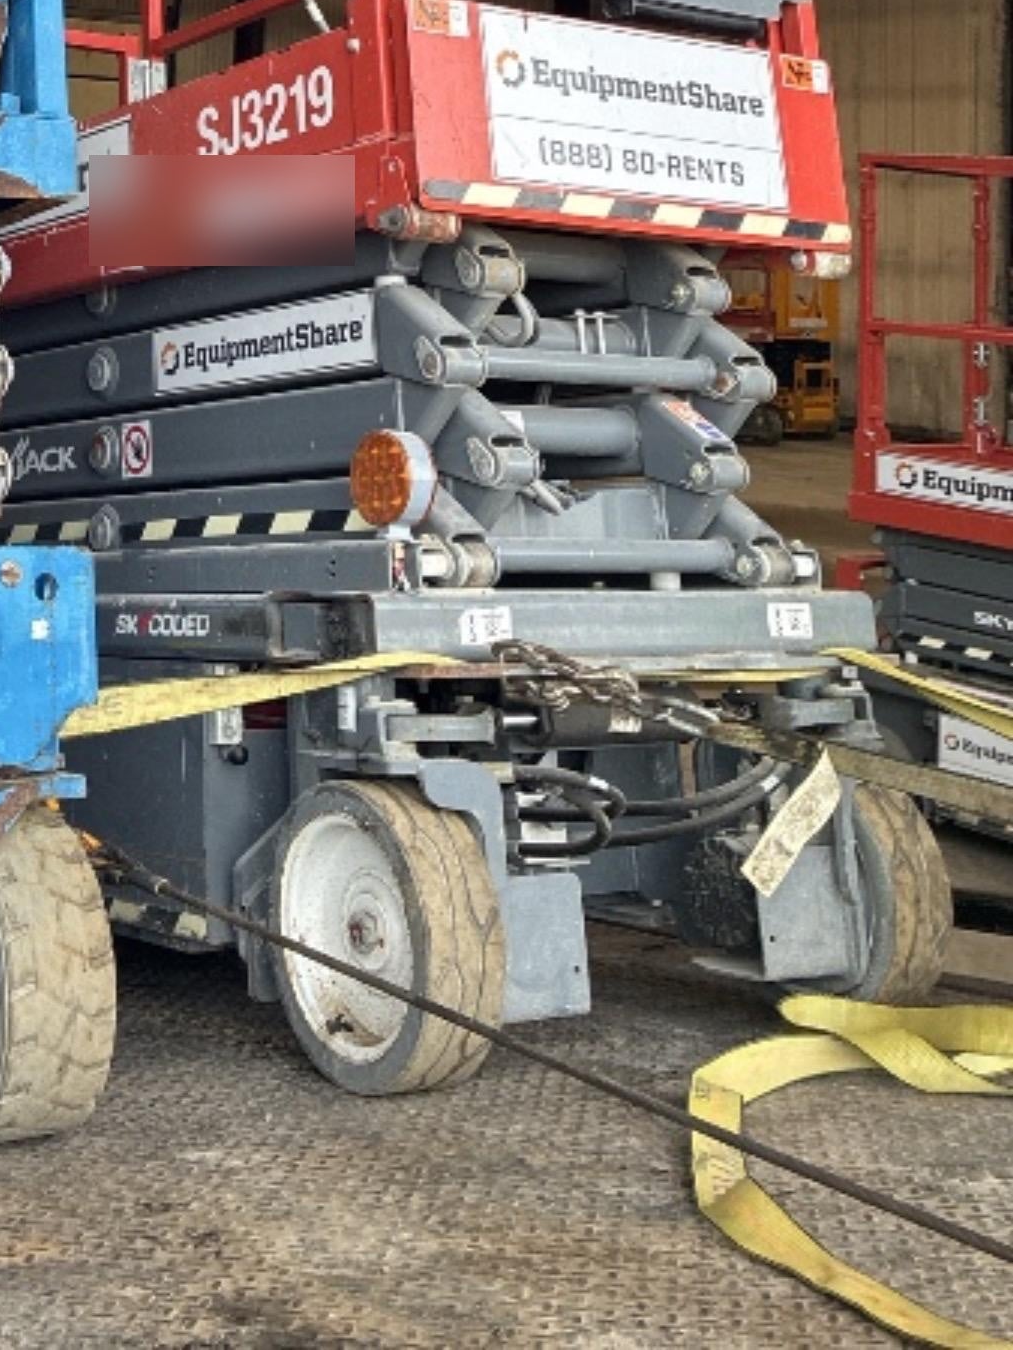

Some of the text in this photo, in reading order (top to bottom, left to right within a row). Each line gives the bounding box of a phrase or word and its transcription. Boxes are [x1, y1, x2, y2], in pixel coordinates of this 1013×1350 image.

[196, 65, 334, 155] SJ3219
[530, 56, 766, 118] EquipmentShare
[538, 136, 745, 187] (888) 80-RENTS
[182, 319, 364, 369] EquipmentShare
